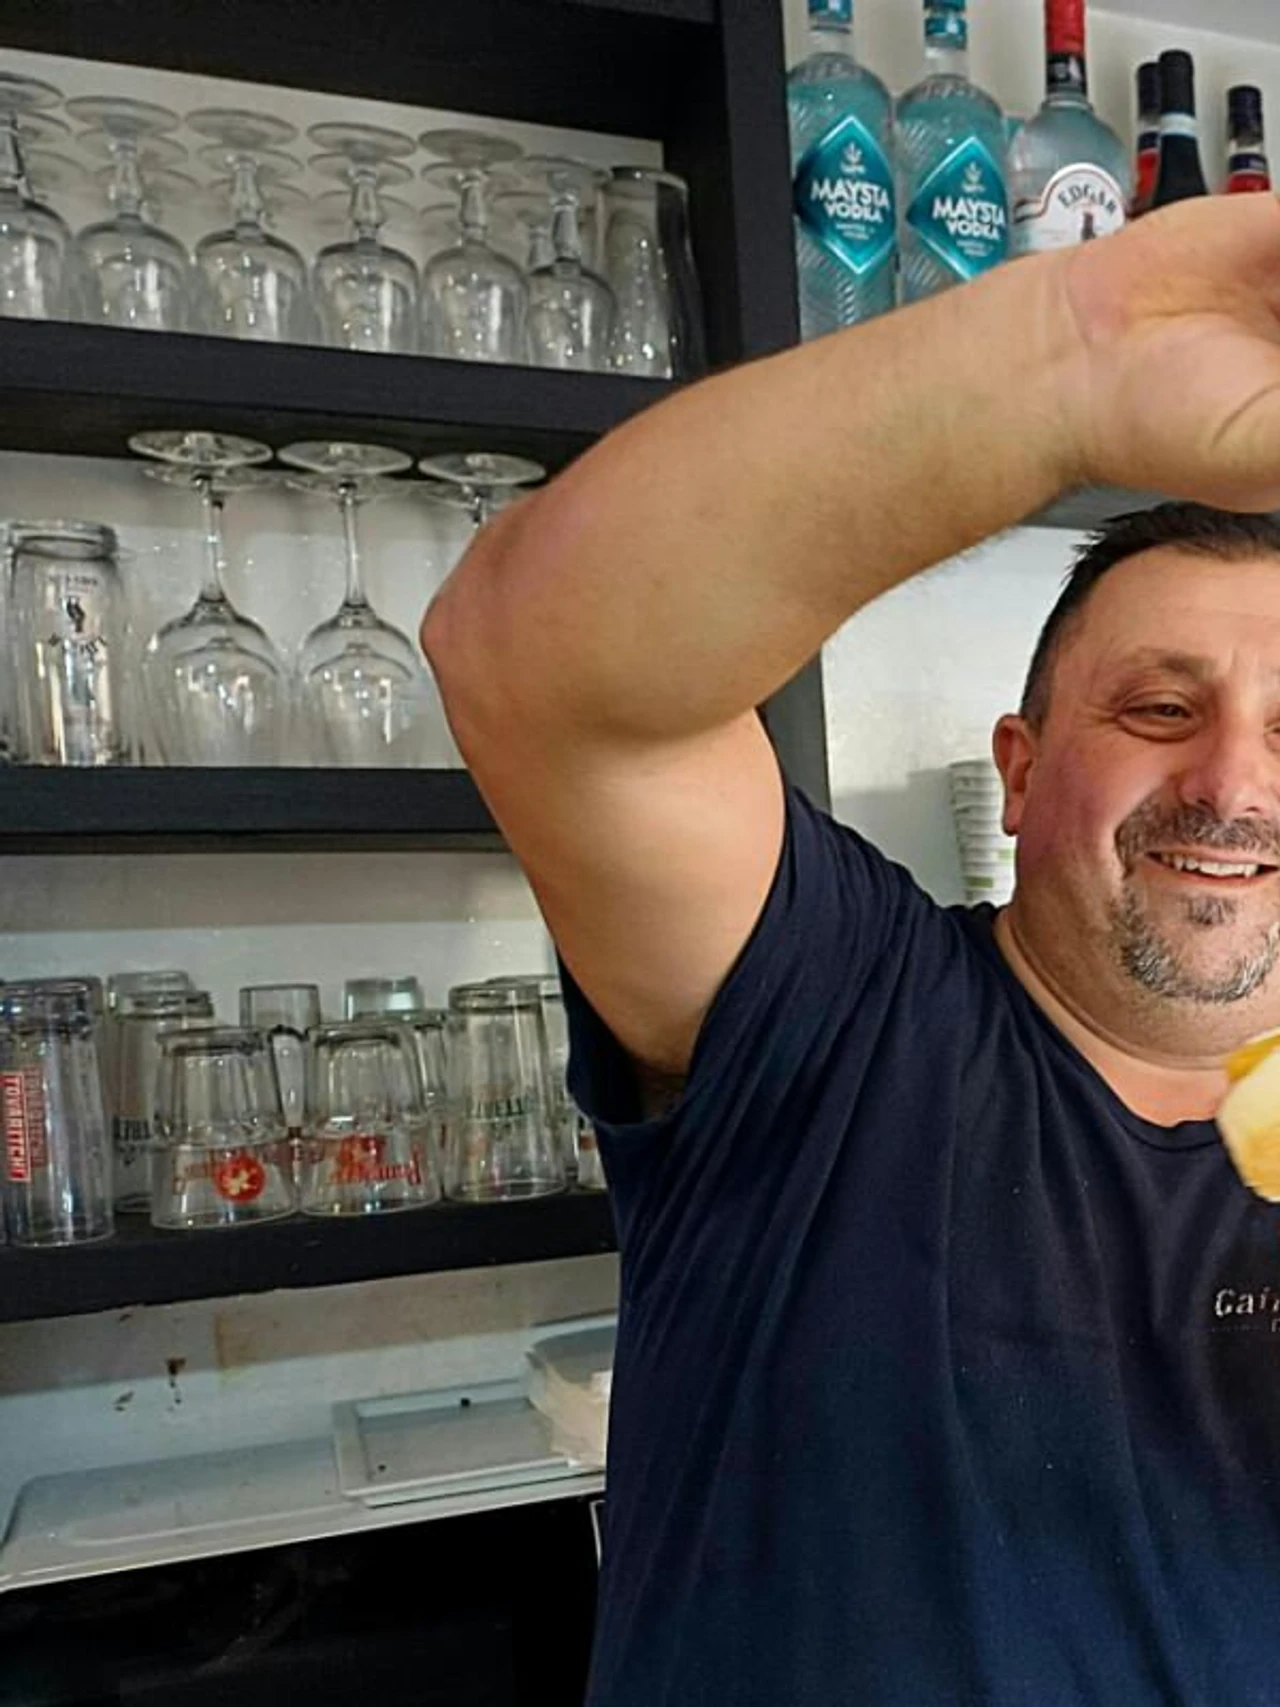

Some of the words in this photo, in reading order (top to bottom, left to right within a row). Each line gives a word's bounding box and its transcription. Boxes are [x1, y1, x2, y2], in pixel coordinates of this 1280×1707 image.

[810, 178, 890, 210] MAYSTA
[824, 202, 884, 224] VODKA
[932, 196, 1006, 226] MAYSTA
[945, 220, 1000, 240] VODKA
